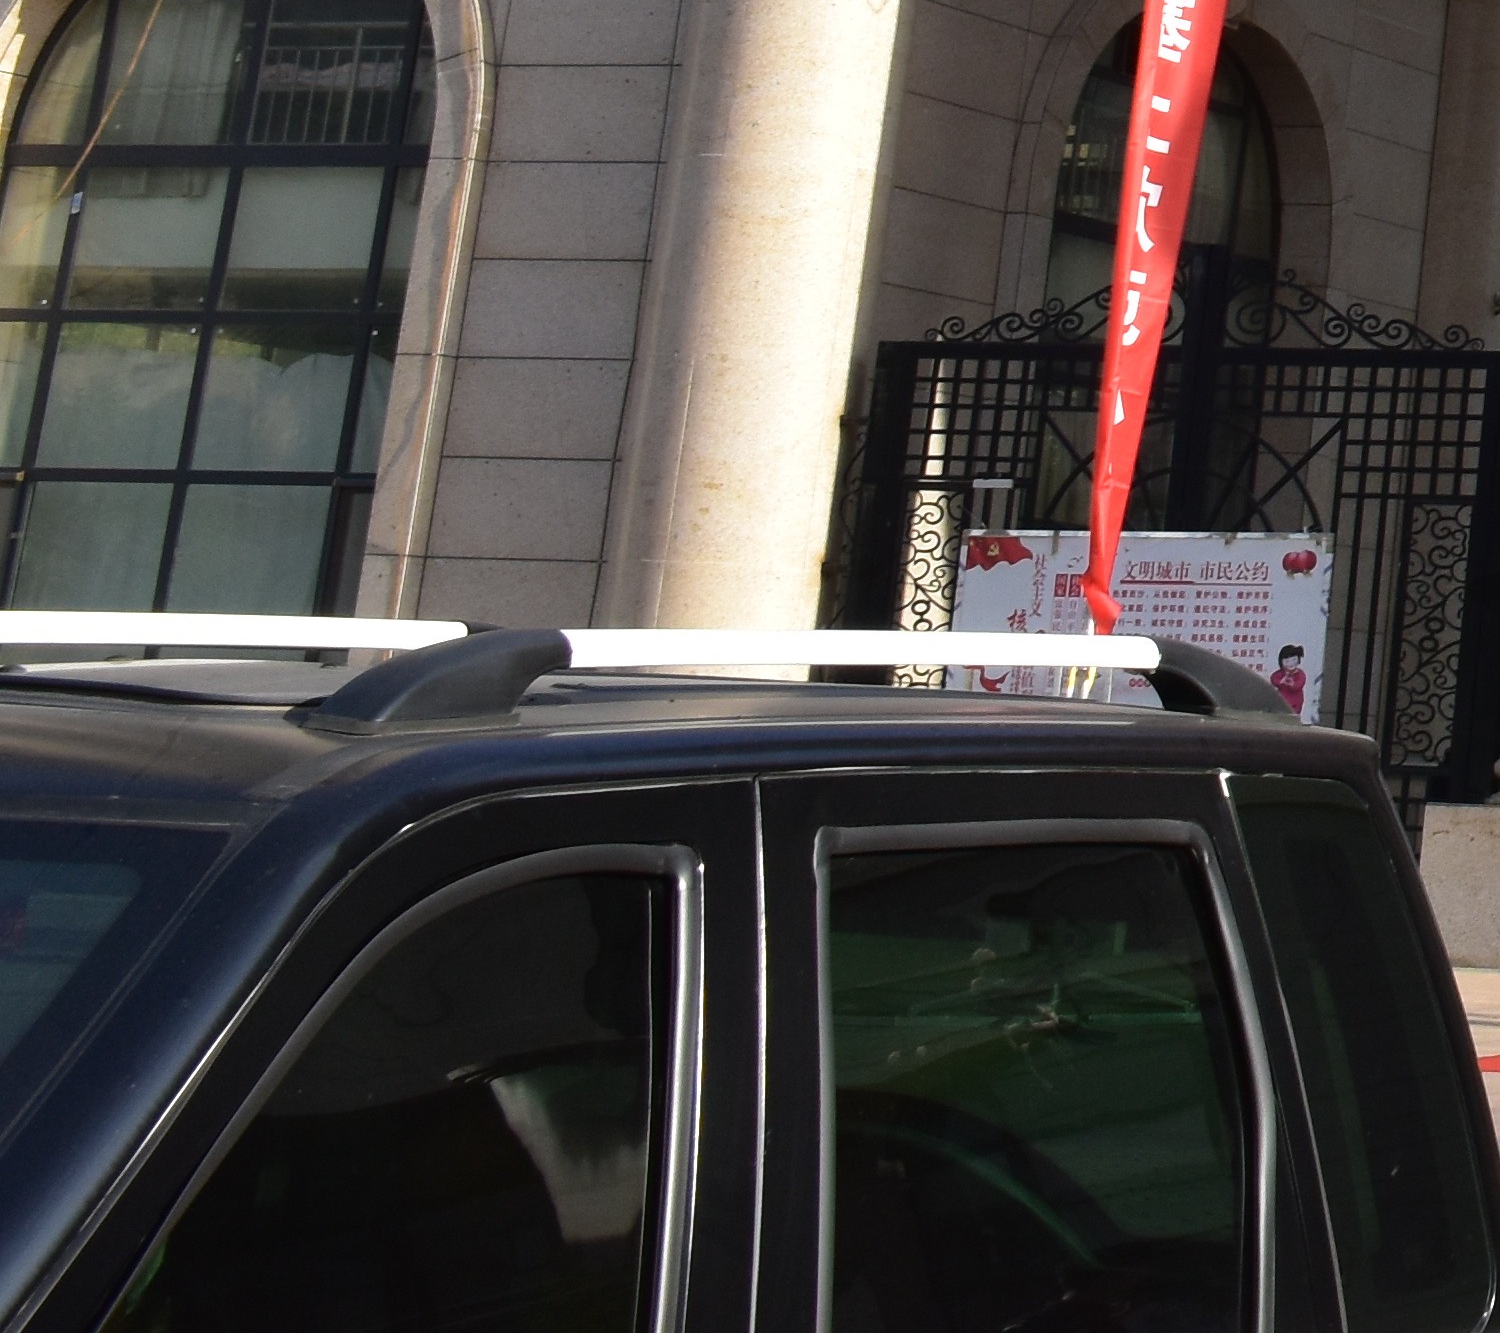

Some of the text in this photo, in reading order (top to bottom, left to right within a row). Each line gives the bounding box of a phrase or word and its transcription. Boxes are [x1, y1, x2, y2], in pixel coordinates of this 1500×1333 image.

[1124, 560, 1270, 582] 文明城市 市民公约
